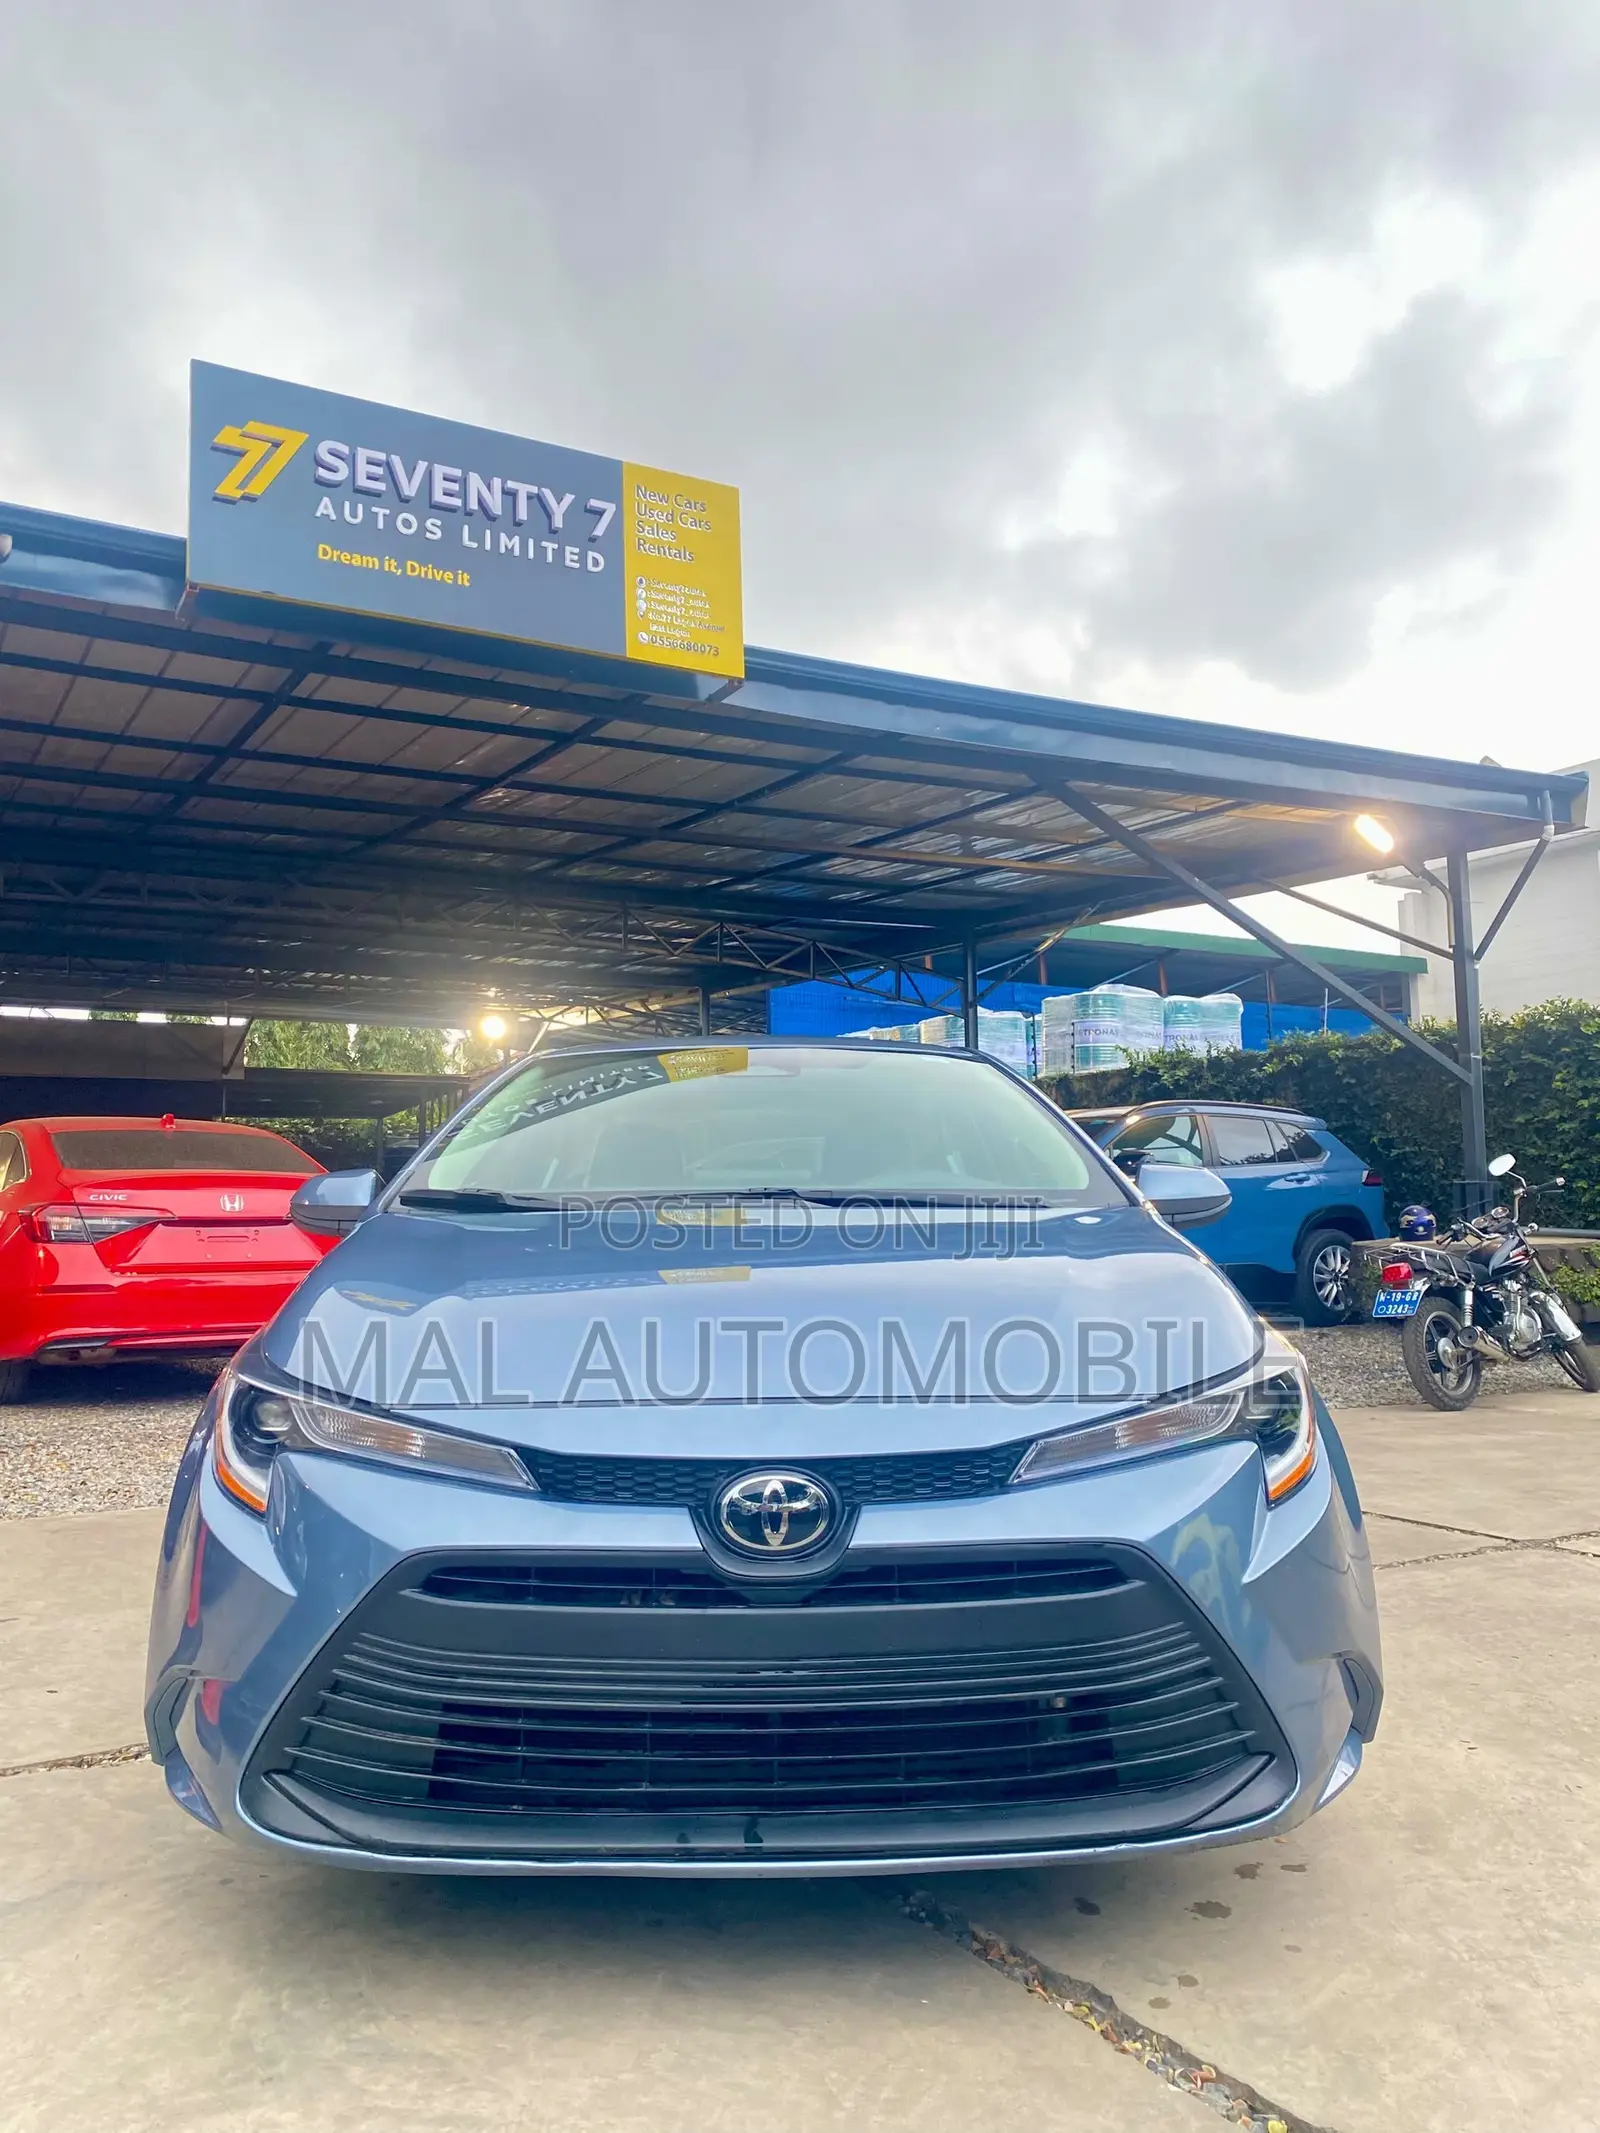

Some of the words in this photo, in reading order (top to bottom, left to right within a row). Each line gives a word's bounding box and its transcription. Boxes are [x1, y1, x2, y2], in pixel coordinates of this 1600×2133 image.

[314, 440, 575, 534] SEVENTY
[583, 498, 617, 542] 7
[635, 484, 669, 502] New
[673, 494, 707, 513] Cars
[635, 502, 674, 524] Used
[678, 512, 712, 532] Cars
[314, 496, 442, 541] AUTOS
[462, 524, 605, 573] LIMITED
[636, 520, 677, 542] Sales
[636, 537, 695, 563] Rentals
[317, 544, 379, 570] Dream
[384, 556, 402, 575] it,
[406, 560, 454, 584] Drive
[457, 570, 471, 586] it
[650, 635, 720, 657] 0556680073
[89, 1193, 128, 1202] CIVIC
[1386, 1304, 1409, 1315] 3243
